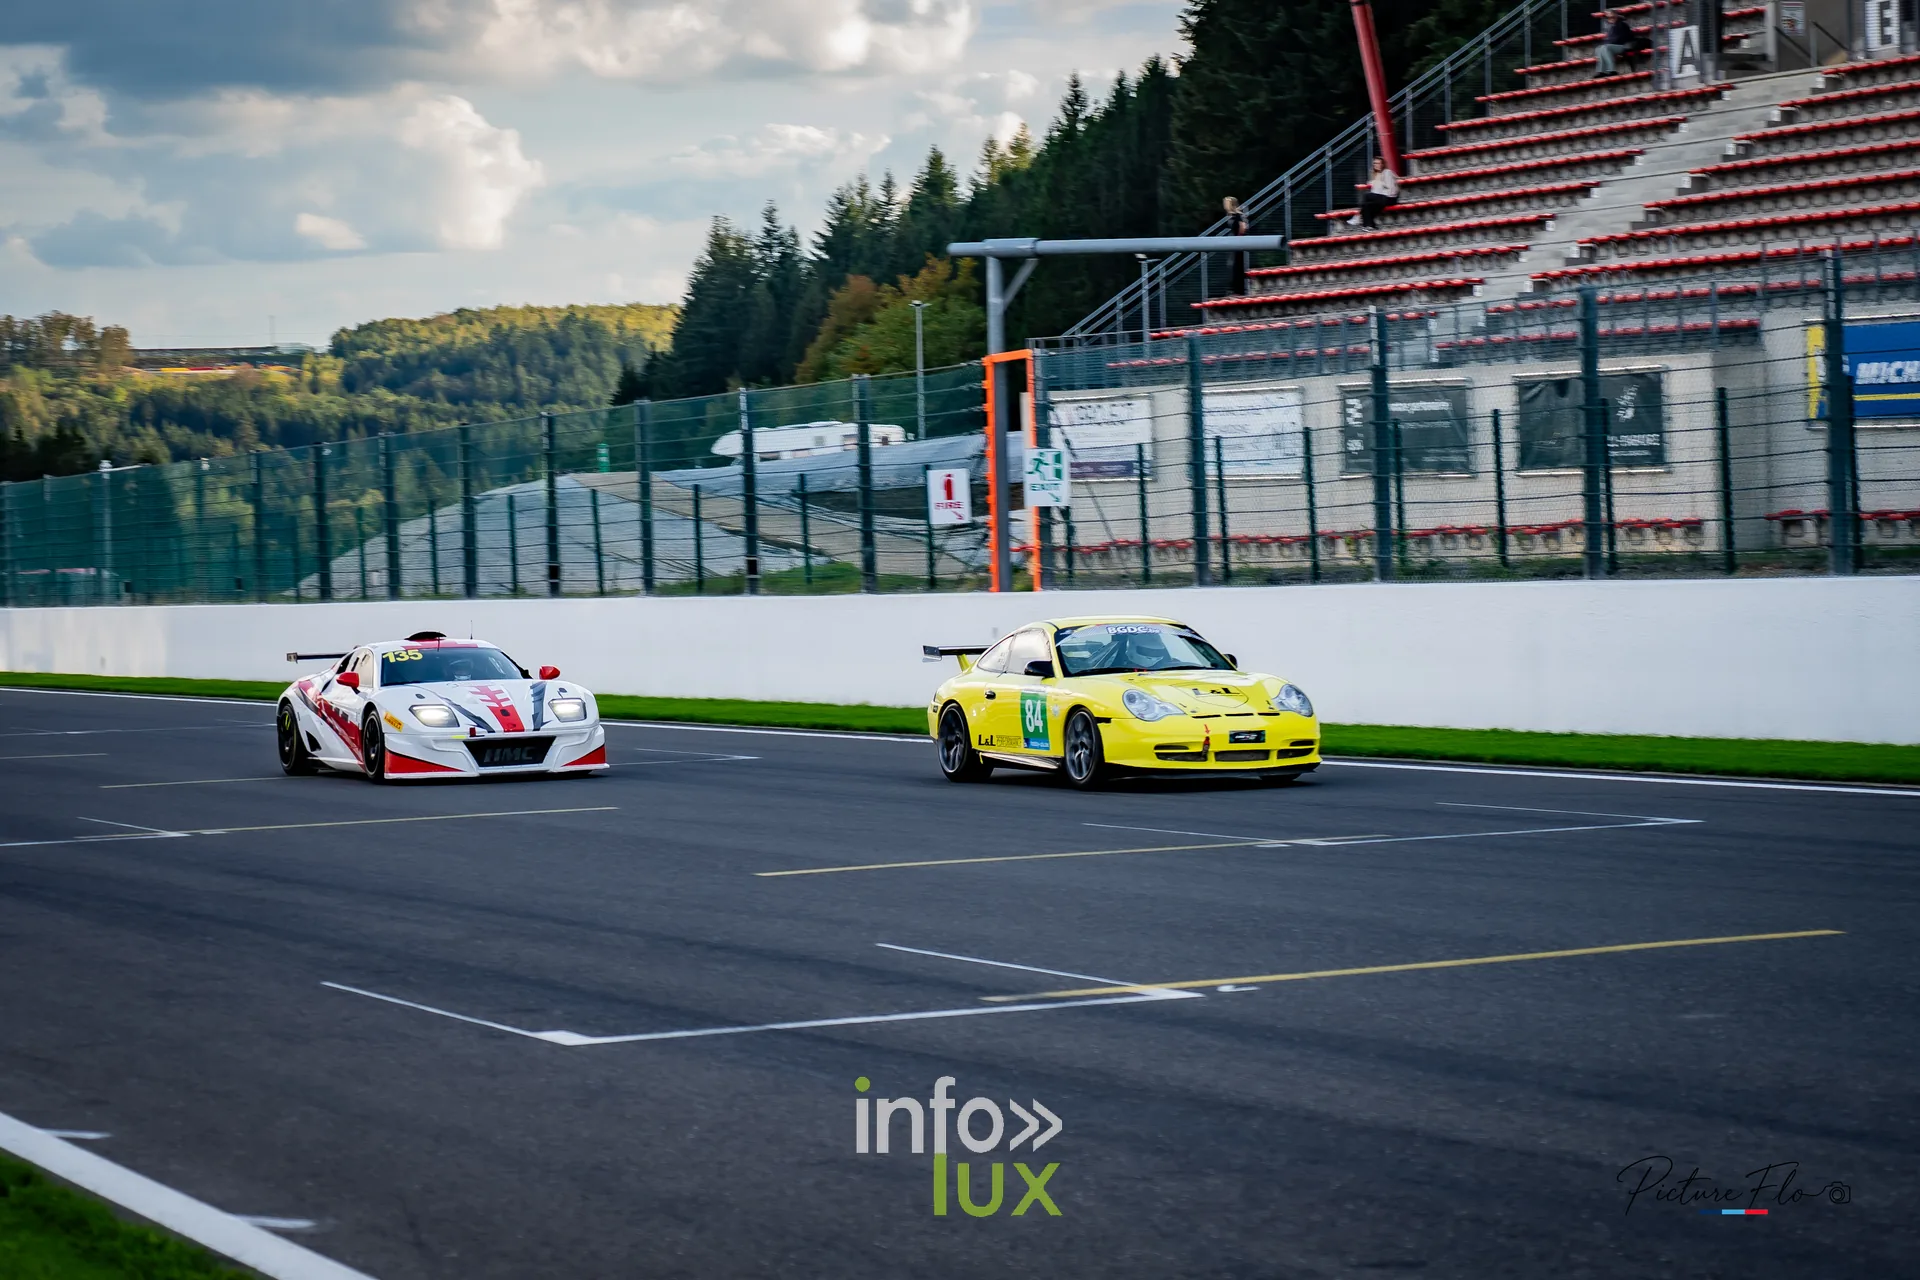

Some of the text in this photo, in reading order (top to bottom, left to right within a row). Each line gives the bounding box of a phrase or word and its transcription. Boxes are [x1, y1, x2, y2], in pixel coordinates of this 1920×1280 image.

[1678, 30, 1700, 74] A
[1030, 483, 1062, 491] EXIT
[935, 501, 964, 510] FIRE
[382, 649, 423, 663] 135
[1025, 699, 1044, 733] 84
[978, 734, 996, 747] L&L
